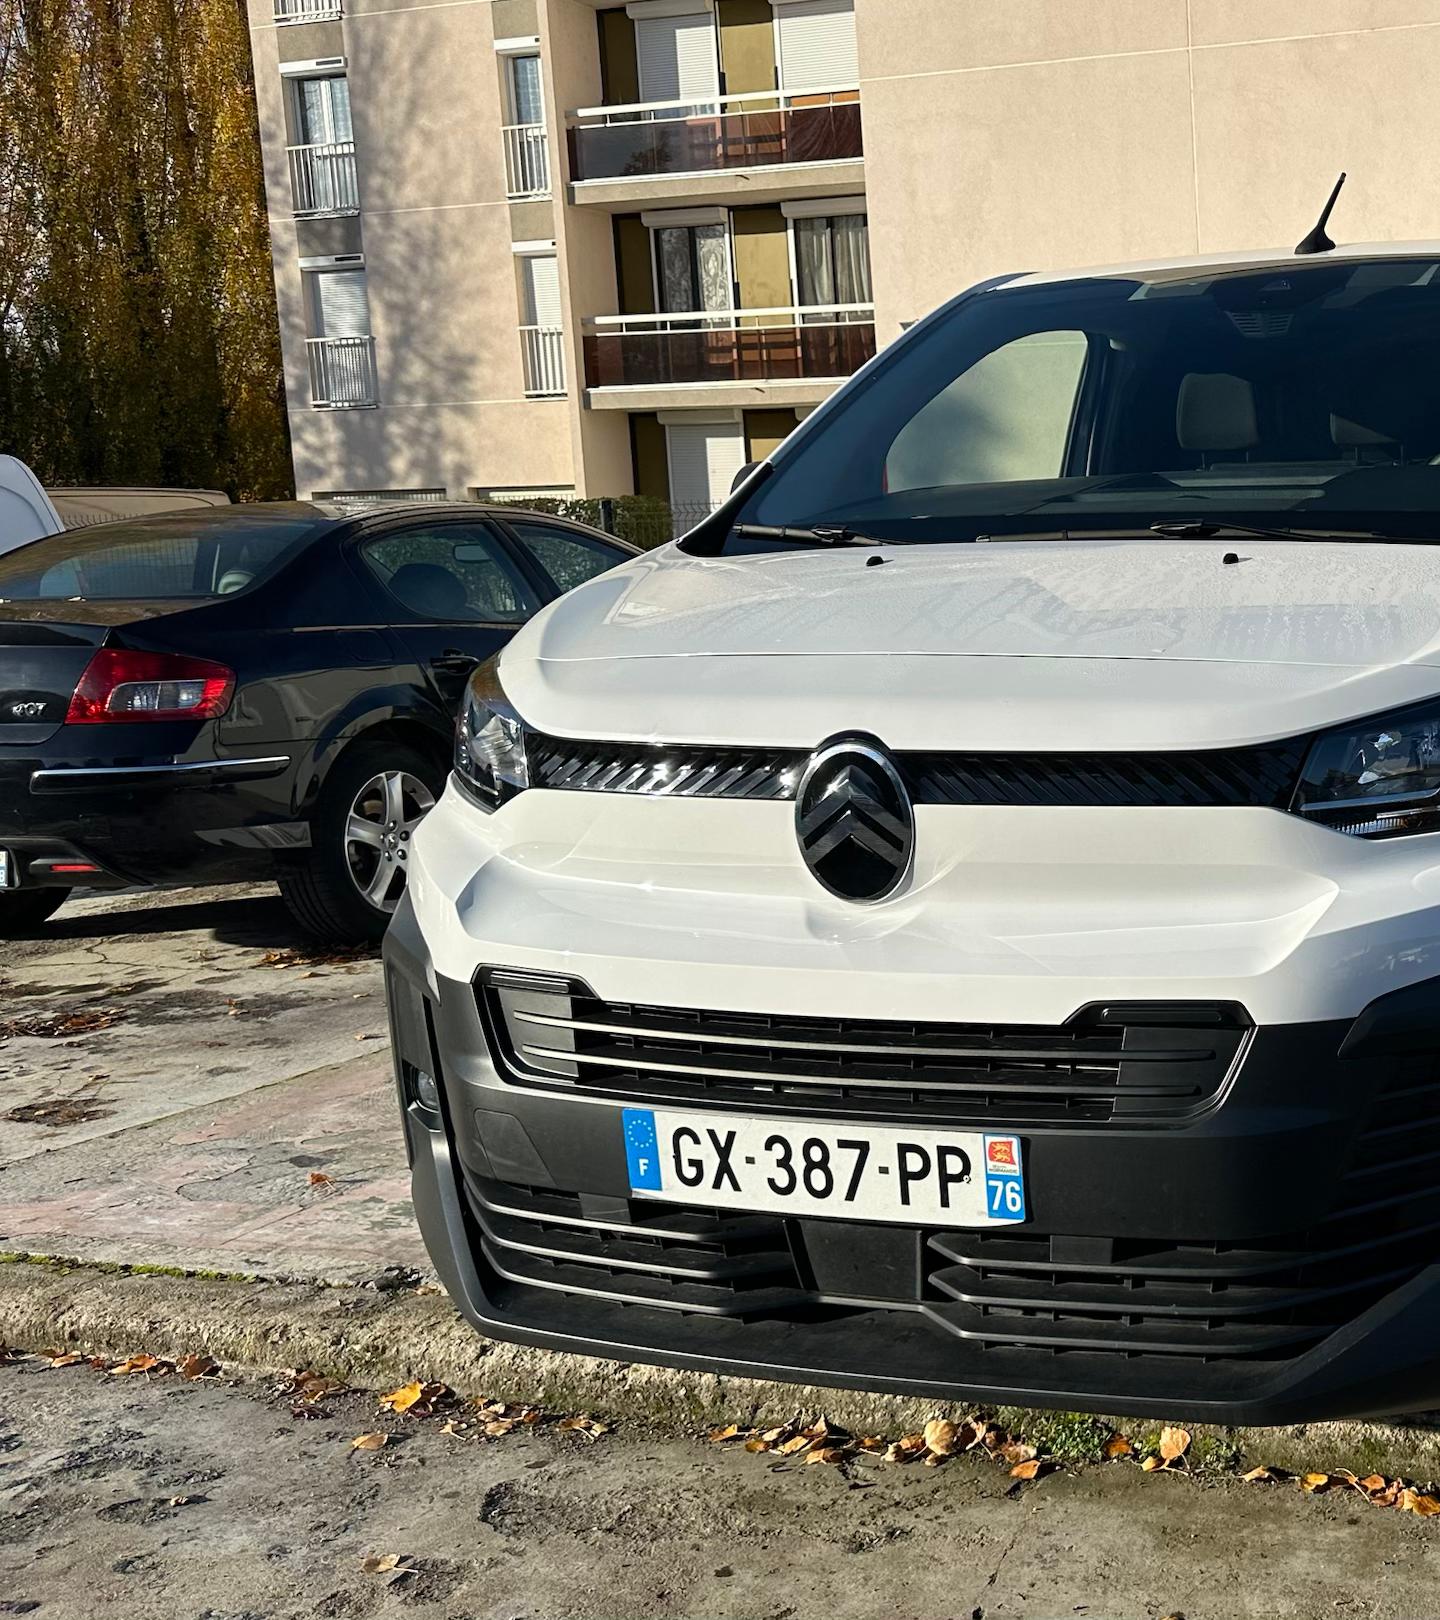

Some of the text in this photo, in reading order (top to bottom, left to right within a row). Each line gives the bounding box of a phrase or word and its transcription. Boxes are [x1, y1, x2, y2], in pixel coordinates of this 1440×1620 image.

[639, 1159, 648, 1176] F
[672, 1126, 972, 1208] GX-387-PP
[988, 1180, 1022, 1212] 76
